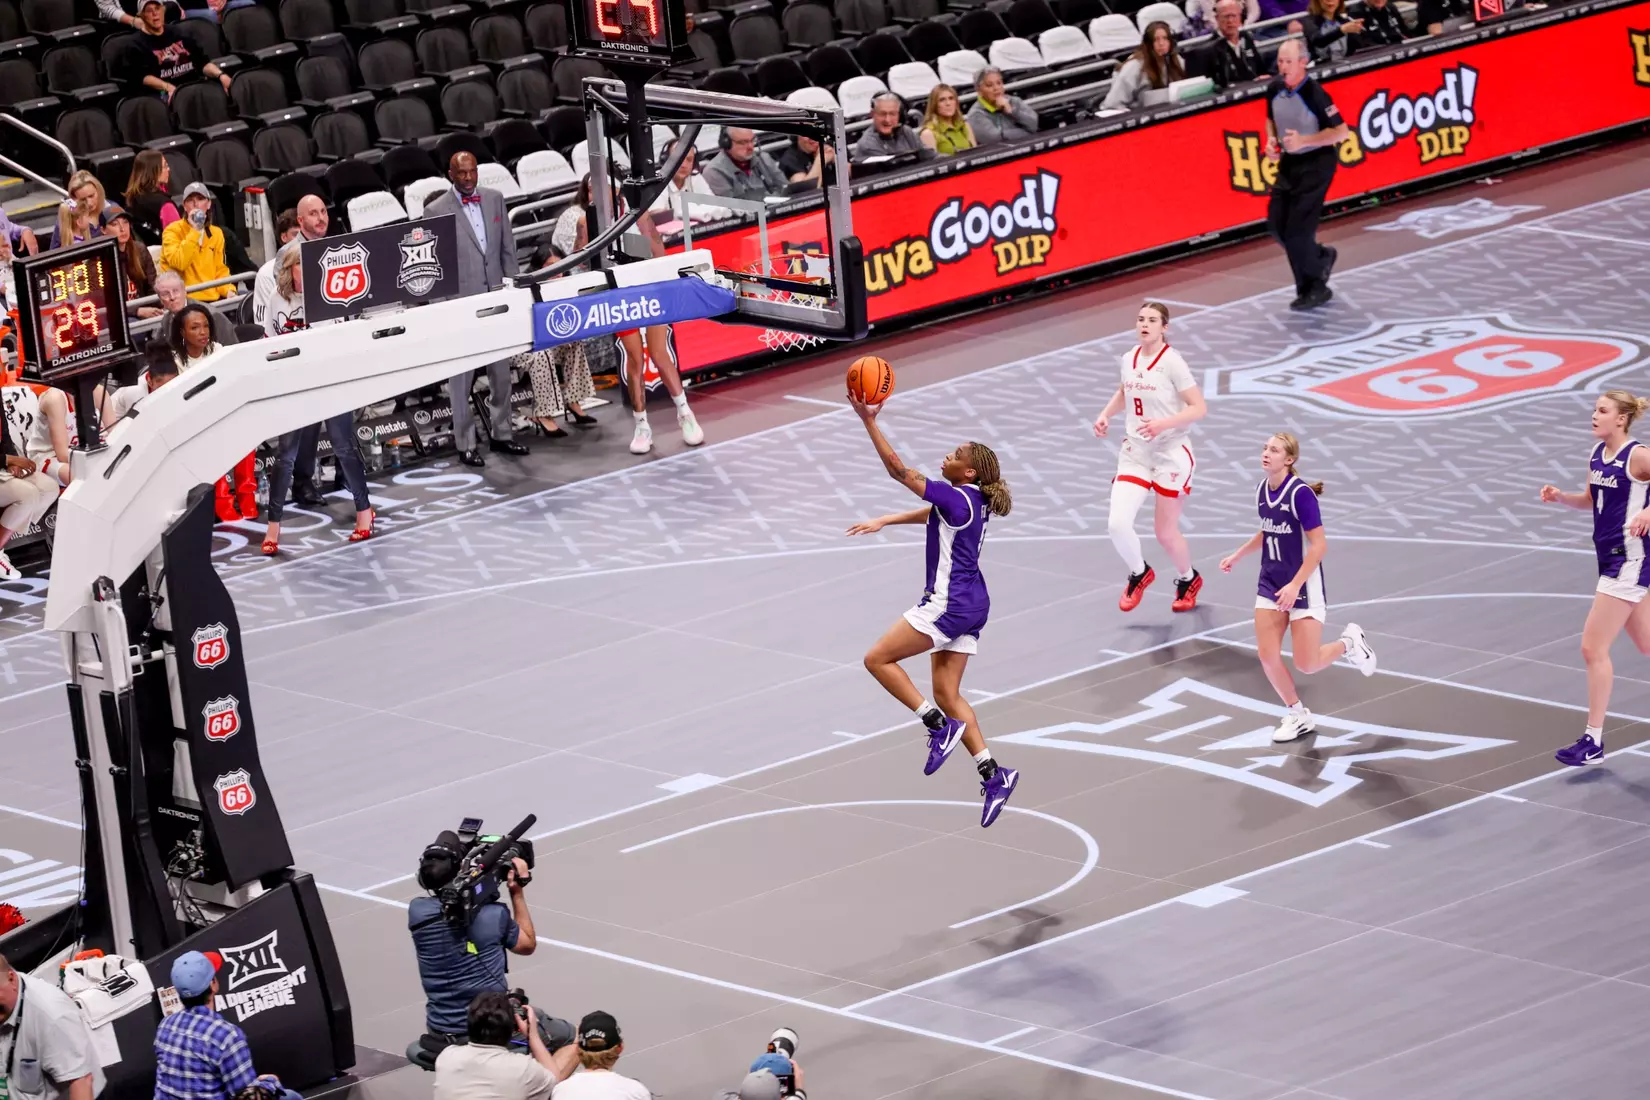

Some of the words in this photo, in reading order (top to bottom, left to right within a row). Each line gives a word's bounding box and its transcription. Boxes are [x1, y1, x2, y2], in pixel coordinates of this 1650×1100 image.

[600, 41, 649, 53] DAKTRONICS
[1359, 66, 1478, 150] Good!
[1416, 125, 1471, 163] DIP
[931, 173, 1059, 260] Good!
[327, 251, 362, 267] PHILLIPS
[401, 240, 436, 268] XII
[993, 234, 1051, 273] DIP
[52, 261, 104, 301] 3:01
[330, 268, 360, 294] 66
[400, 266, 439, 279] BASKETBALL
[400, 271, 440, 284] TOURNAMENT
[584, 295, 661, 329] Allstate
[53, 301, 99, 349] 29
[52, 343, 114, 367] DAKTRONICS
[1253, 326, 1477, 387] PHILLIPS
[1367, 343, 1564, 402] 66
[1133, 397, 1143, 416] 8
[374, 421, 408, 437] Allstate
[1266, 536, 1281, 561] 11
[197, 628, 222, 642] PHILLIPS
[199, 640, 221, 661] 66
[208, 701, 233, 715] PHILLIPS
[211, 714, 233, 734] 66
[219, 774, 245, 789] PHILLIPS
[225, 787, 248, 808] 66
[158, 807, 200, 822] DAKTRONICS
[218, 929, 289, 991] XII
[215, 995, 227, 1012] A
[226, 965, 307, 1007] DIFFERENT
[235, 988, 296, 1023] LEAGUE
